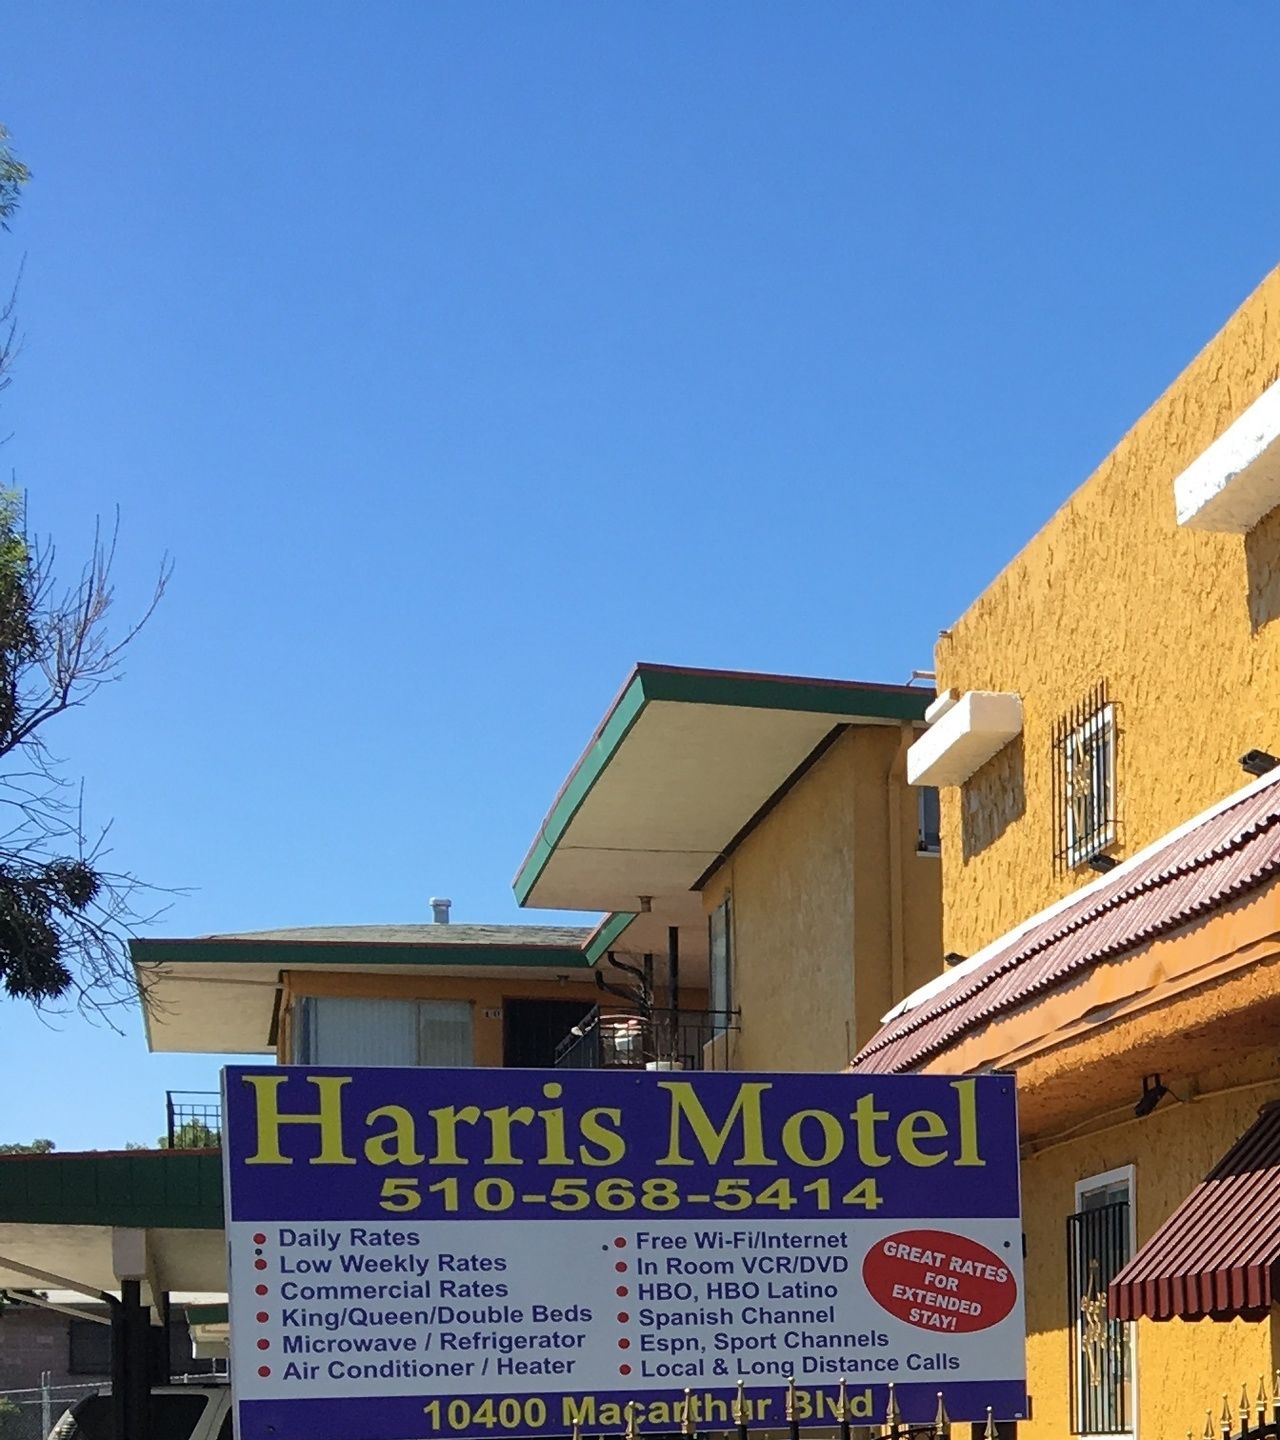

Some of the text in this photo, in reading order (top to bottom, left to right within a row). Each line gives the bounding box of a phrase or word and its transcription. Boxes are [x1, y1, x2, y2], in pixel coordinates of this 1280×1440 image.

[241, 1074, 987, 1168] Harris Motel
[379, 1177, 883, 1212] 510-568-5414
[279, 1228, 421, 1251] Daily Rates
[636, 1231, 849, 1250] Free Wi-Fi/Internet
[280, 1254, 508, 1277] Low Weekly Rates
[637, 1256, 849, 1276] In Room VCR/DVD
[883, 1241, 1009, 1284] GREAT RATES
[280, 1280, 509, 1301] Commercial Rates
[638, 1281, 838, 1303] HBO, HBO Latino
[924, 1271, 959, 1292] FOR
[892, 1284, 982, 1317] EXTENDED
[281, 1304, 593, 1331] King/Queen/Double Beds
[639, 1305, 835, 1330] Spanish Channel
[908, 1307, 958, 1331] STAY!
[283, 1331, 586, 1354] Microwave / Refrigerator
[640, 1330, 889, 1356] Espn, Sport Channels
[282, 1357, 576, 1381] Air Conditioner / Heater
[641, 1353, 960, 1379] Local & Long Distance Calls
[423, 1397, 547, 1430] 10400
